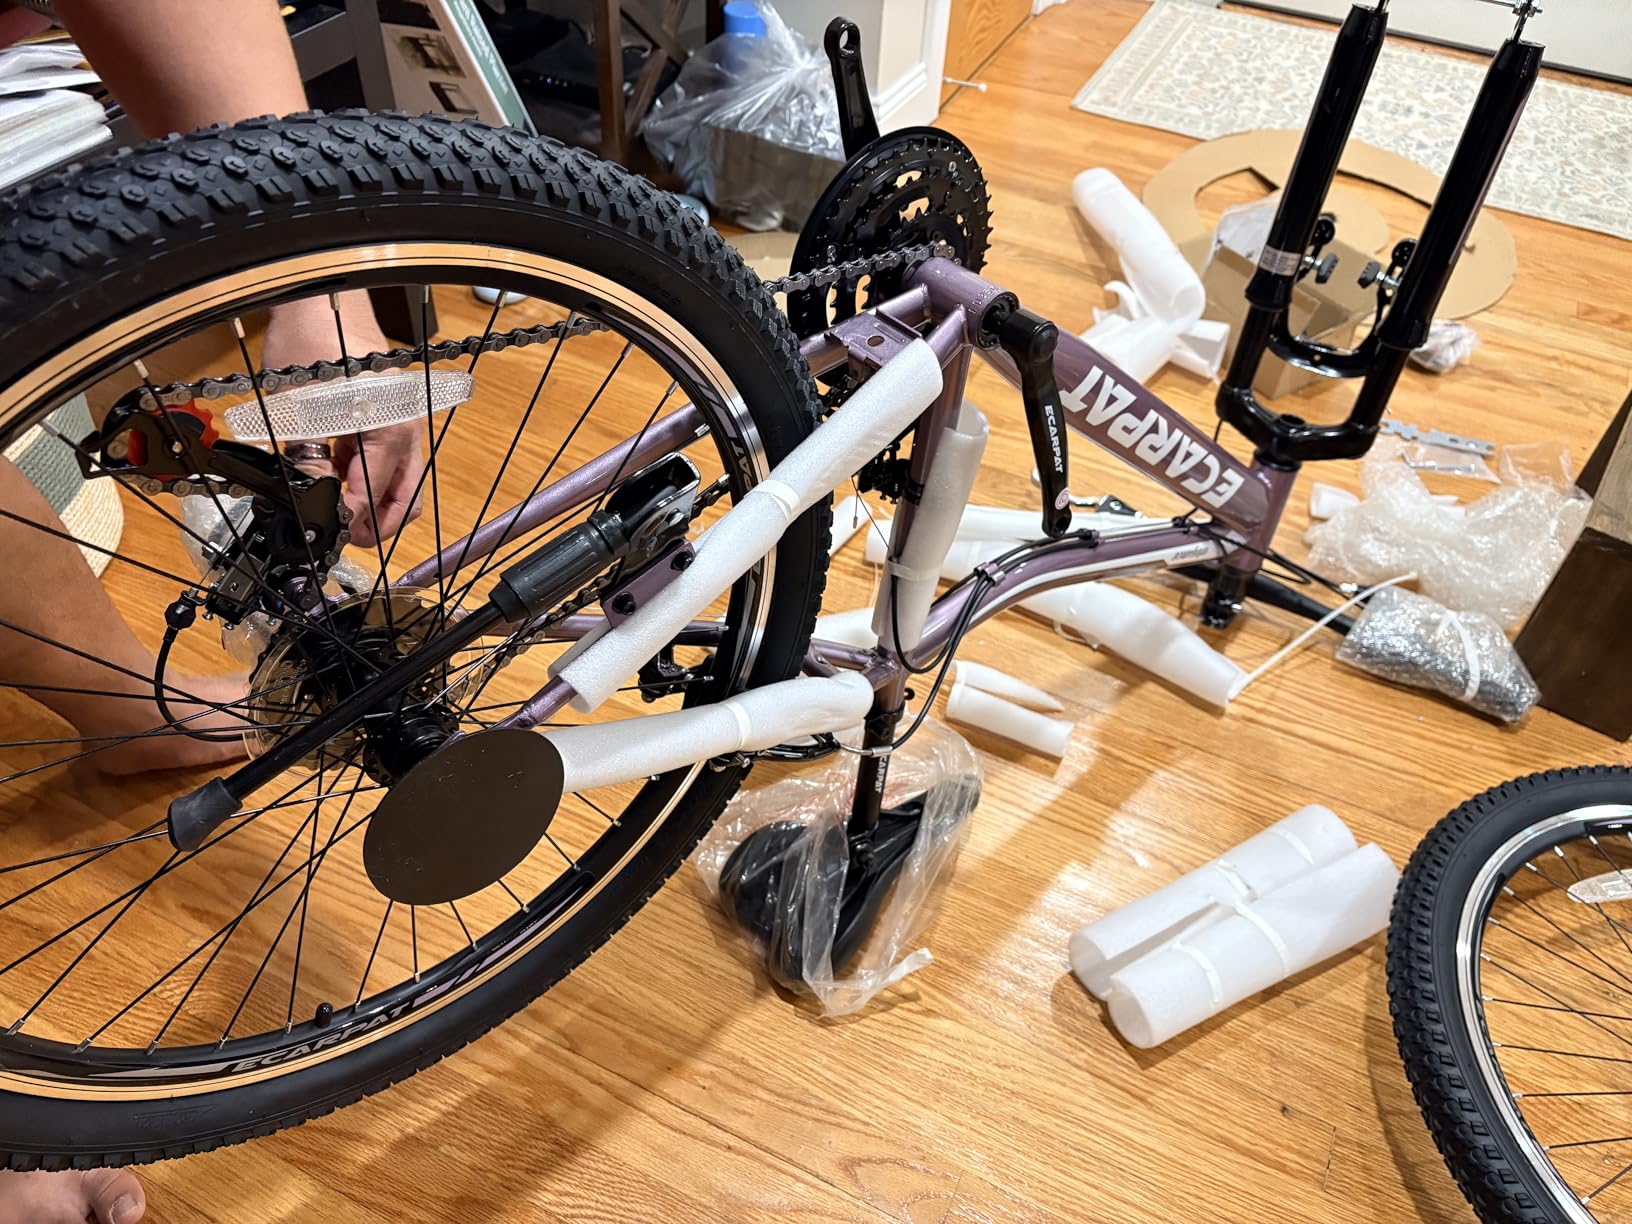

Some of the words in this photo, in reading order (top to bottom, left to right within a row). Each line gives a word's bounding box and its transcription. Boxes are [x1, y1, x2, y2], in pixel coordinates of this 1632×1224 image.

[1044, 404, 1064, 473] ECARPAT
[1059, 365, 1245, 508] ECARPAT
[875, 755, 888, 793] CARPAT
[231, 1001, 410, 1073] ECARPAT
